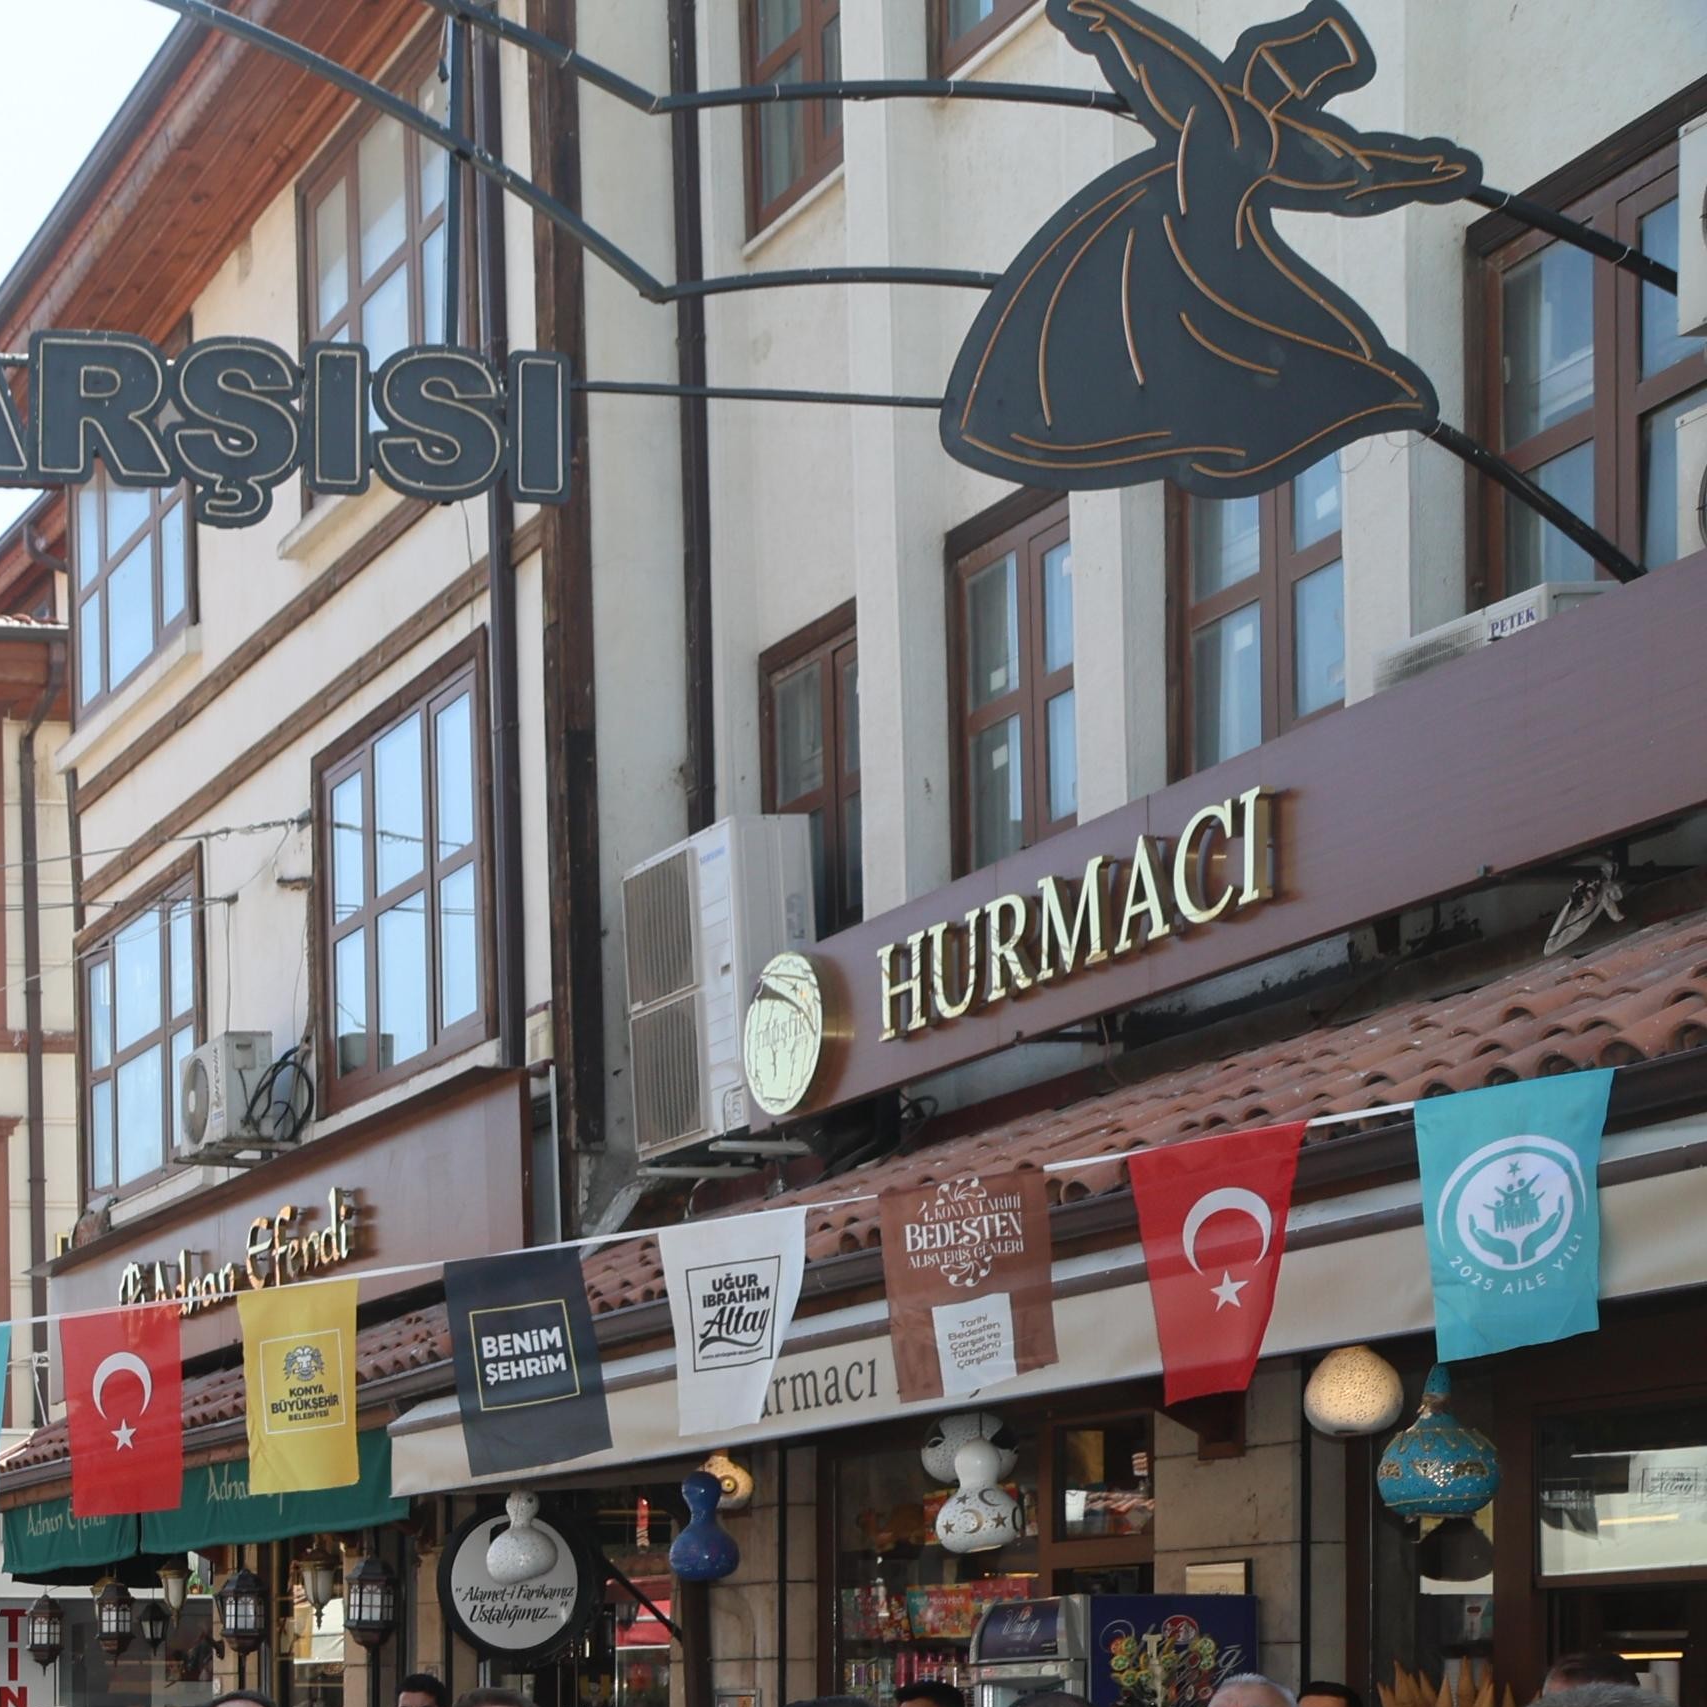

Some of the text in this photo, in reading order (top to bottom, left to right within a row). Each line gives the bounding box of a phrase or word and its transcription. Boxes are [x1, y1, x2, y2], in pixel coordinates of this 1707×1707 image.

[1490, 606, 1535, 637] PETEK
[876, 785, 1277, 1043] HURMACI
[246, 1186, 350, 1290] Efendi
[904, 1211, 1023, 1253] BEDESTEN
[1449, 1233, 1583, 1294] 2025 AİLE YILI
[712, 1273, 759, 1292] UĞUR
[702, 1286, 771, 1308] İBRAHİM
[699, 1304, 771, 1353] Altay
[948, 1322, 1001, 1340] Bedesten
[959, 1313, 988, 1329] Tarihi
[481, 1325, 563, 1360] BENİM
[987, 1332, 1001, 1340] ve
[952, 1341, 1002, 1360] Türbeönü
[484, 1351, 567, 1386] ŞEHRİM
[288, 1386, 325, 1398] KONYA
[761, 1358, 877, 1419] rmacı
[270, 1394, 340, 1415] BÜYÜKŞEHİR
[288, 1411, 330, 1422] BELEDİYESİ
[206, 1466, 250, 1504] Adna
[518, 1584, 575, 1600] Farikamız
